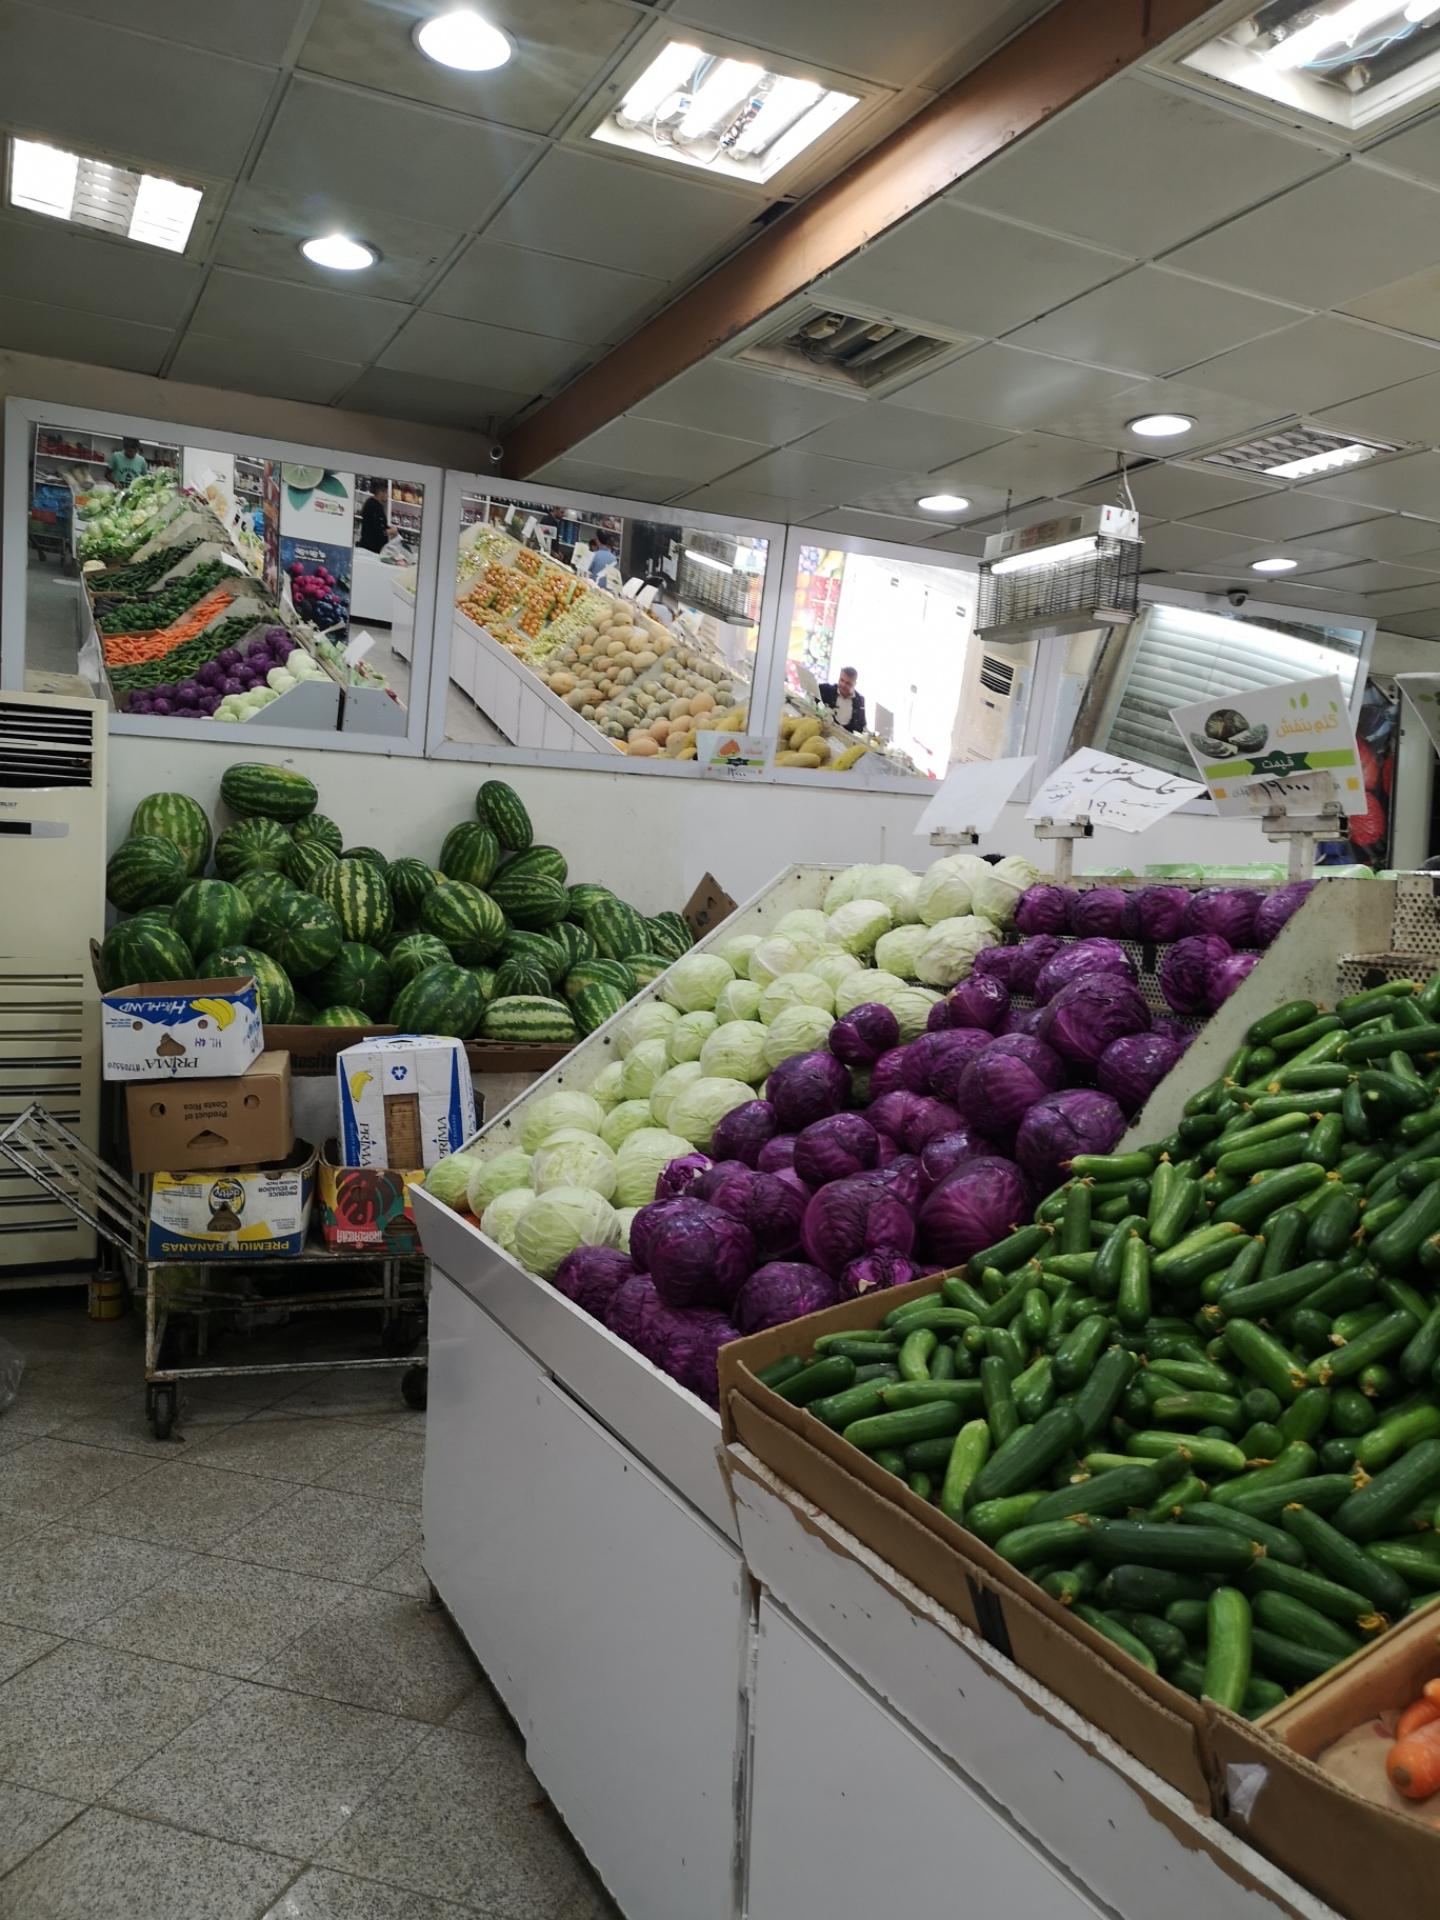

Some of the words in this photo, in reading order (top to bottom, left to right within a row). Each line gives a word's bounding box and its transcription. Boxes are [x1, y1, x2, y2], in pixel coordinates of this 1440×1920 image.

[1275, 718, 1313, 738] بنفش
[1315, 713, 1338, 733] کلم
[1262, 756, 1294, 769] قیمت
[1259, 780, 1310, 799] ۱۹۰۰۰
[1088, 799, 1127, 815] ۱۹۰۰۰
[120, 1001, 187, 1014] HIGHLAND
[145, 1057, 199, 1074] PRIMA
[184, 1101, 202, 1110] Rica
[203, 1101, 228, 1109] Costa
[185, 1112, 194, 1121] of
[195, 1110, 228, 1120] Product
[360, 1123, 377, 1167] PRIMA
[161, 1241, 225, 1252] BANANAS
[228, 1241, 290, 1251] PREMIUM
